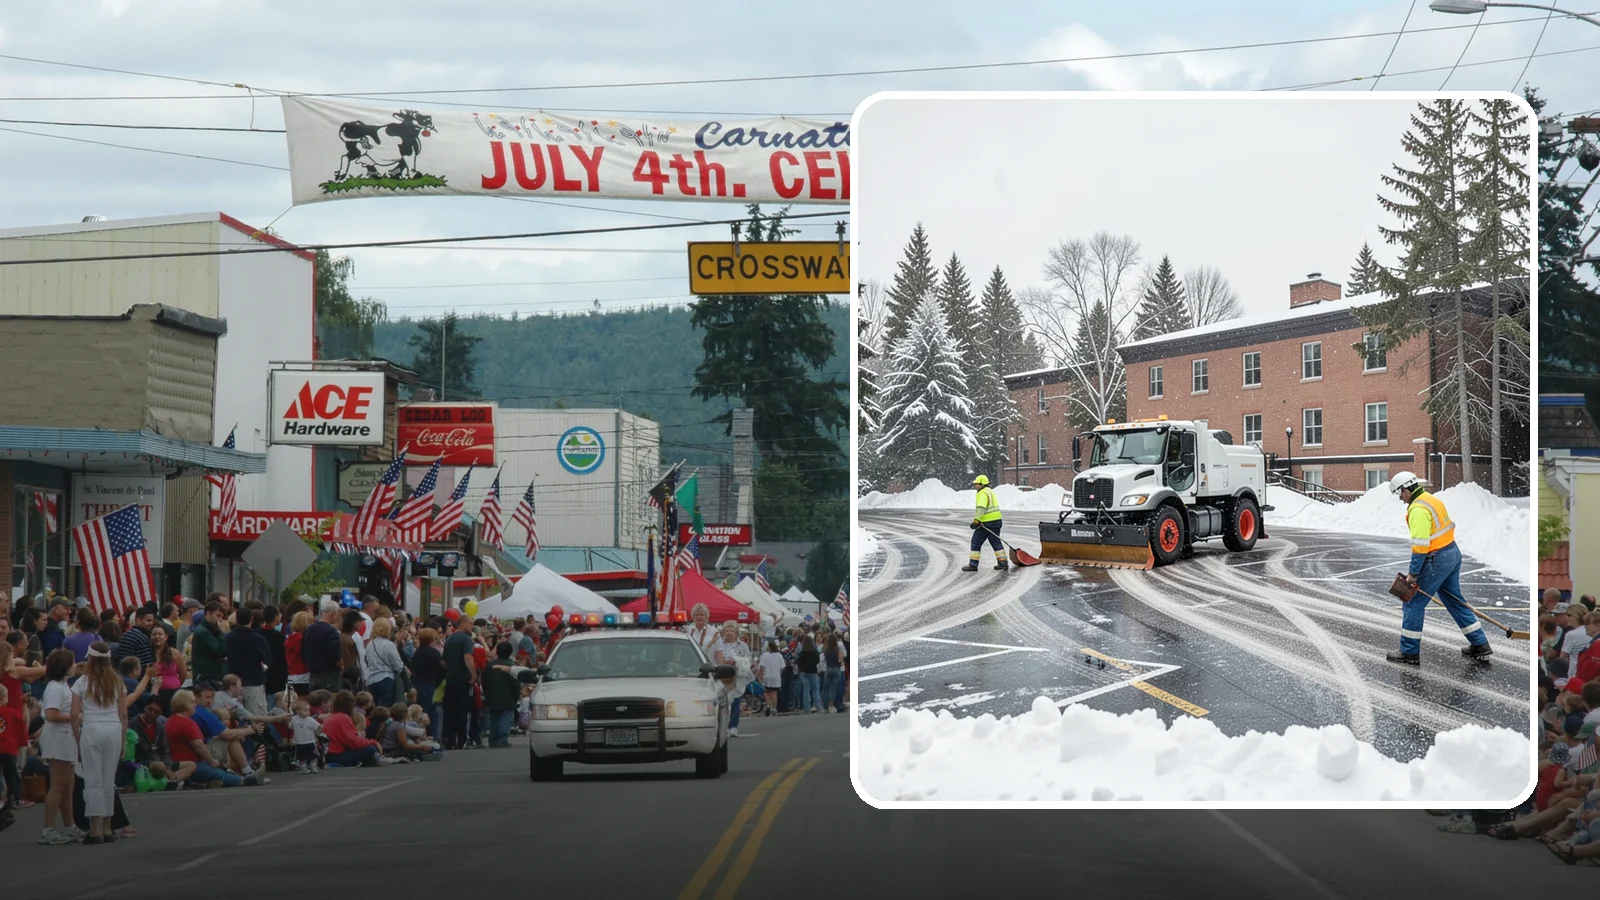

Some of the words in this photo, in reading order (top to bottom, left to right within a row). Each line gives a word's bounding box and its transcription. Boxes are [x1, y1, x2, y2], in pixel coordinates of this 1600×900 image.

[695, 121, 850, 150] Carnat
[481, 140, 606, 193] JULY
[697, 253, 850, 280] CROSSWA
[283, 380, 373, 420] ACE
[405, 409, 452, 422] CEDAR
[283, 421, 371, 436] Hardware
[353, 467, 385, 480] Simpl
[83, 484, 93, 494] St.
[95, 485, 124, 495] Vincent
[126, 486, 136, 495] de
[138, 486, 155, 495] Paul
[213, 515, 331, 535] HARDARE
[688, 526, 741, 535] CRNATION
[699, 535, 730, 543] GLASS
